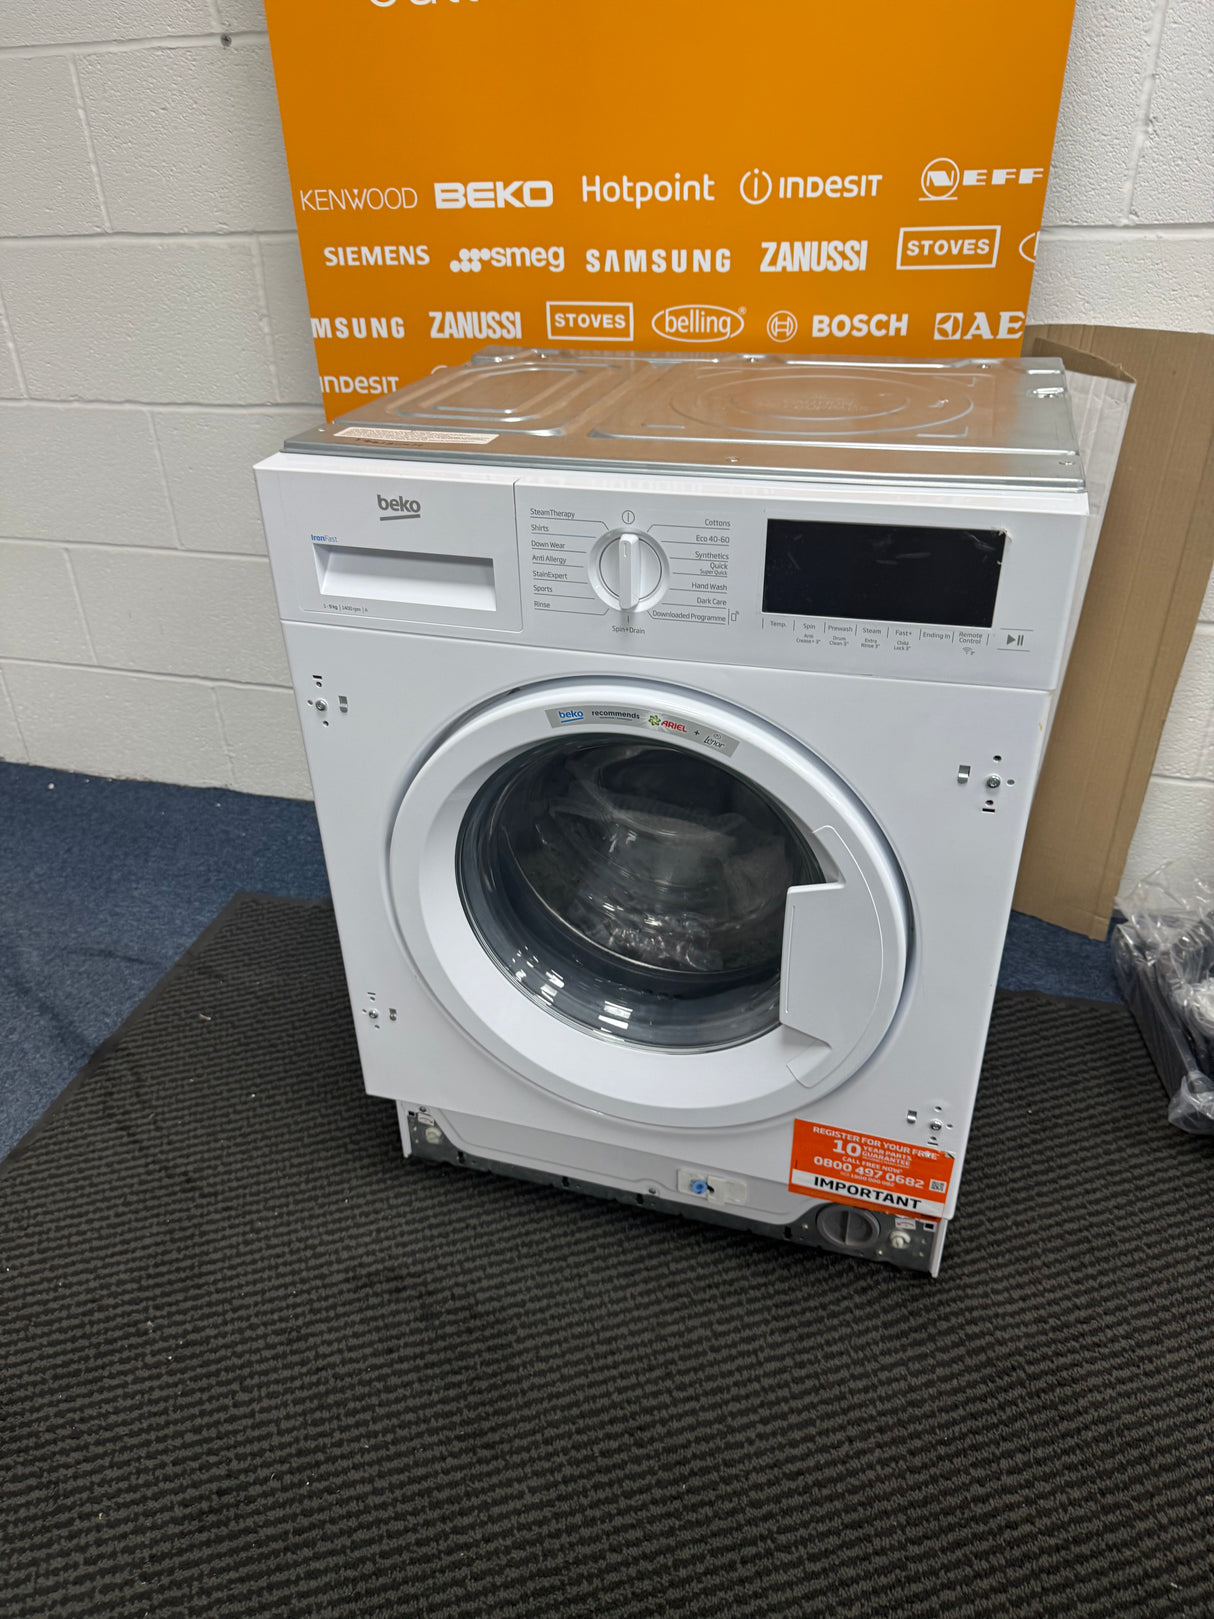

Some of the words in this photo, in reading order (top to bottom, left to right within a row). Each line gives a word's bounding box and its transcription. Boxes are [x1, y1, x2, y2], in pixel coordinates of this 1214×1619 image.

[433, 181, 554, 209] BEKO
[582, 173, 715, 209] Hotpoint
[301, 187, 418, 211] KENWOOD
[906, 238, 990, 256] STOVES
[323, 245, 430, 266] SIEMENS
[490, 246, 565, 273] smeg
[585, 248, 731, 273] SAMSUNG
[759, 240, 868, 272] ZANUSSI
[428, 311, 522, 339] ZANUSSI
[554, 312, 627, 330] STOVES
[665, 311, 732, 338] belling
[811, 313, 908, 338] BOSCH
[376, 494, 421, 513] beko
[529, 507, 576, 519] SteamTherapy
[530, 523, 549, 532] Shirts
[704, 518, 731, 527] Cottons
[310, 534, 338, 543] IronFast
[531, 540, 548, 548] Down
[549, 541, 565, 549] Wear
[695, 534, 707, 543] Eco
[708, 535, 730, 544] 40-60
[532, 554, 546, 562] Anti
[546, 555, 567, 565] Allergy
[695, 550, 729, 560] Synthetics
[710, 562, 728, 570] Quick
[532, 570, 567, 580] StainExpert
[533, 584, 553, 594] Sports
[691, 582, 708, 590] Hand
[709, 583, 727, 591] Wash
[534, 601, 550, 609] Rinse
[696, 597, 710, 605] Dark
[711, 598, 727, 606] Care
[652, 610, 689, 620] Downloaded
[690, 613, 726, 623] Programme
[612, 625, 645, 635] Spin+Drain
[895, 629, 912, 637] Fast+
[922, 632, 944, 640] Ending
[959, 631, 983, 639] Remote
[558, 710, 584, 719] beko
[591, 710, 640, 720] recommends
[660, 720, 688, 733] ARIEL
[703, 735, 725, 749] Lenor
[813, 1126, 860, 1142] REGISTER
[861, 1137, 881, 1147] FOR
[883, 1142, 911, 1154] YOUR
[833, 1139, 862, 1157] 10
[863, 1145, 885, 1154] YEAR
[885, 1150, 912, 1161] PARTS
[842, 1156, 860, 1165] CALL
[861, 1160, 881, 1170] FREE
[862, 1151, 910, 1166] GUARANTEE
[813, 1156, 852, 1172] 0800
[855, 1166, 883, 1179] 497
[885, 1172, 924, 1189] 0682
[814, 1176, 922, 1209] IMPORTANT
